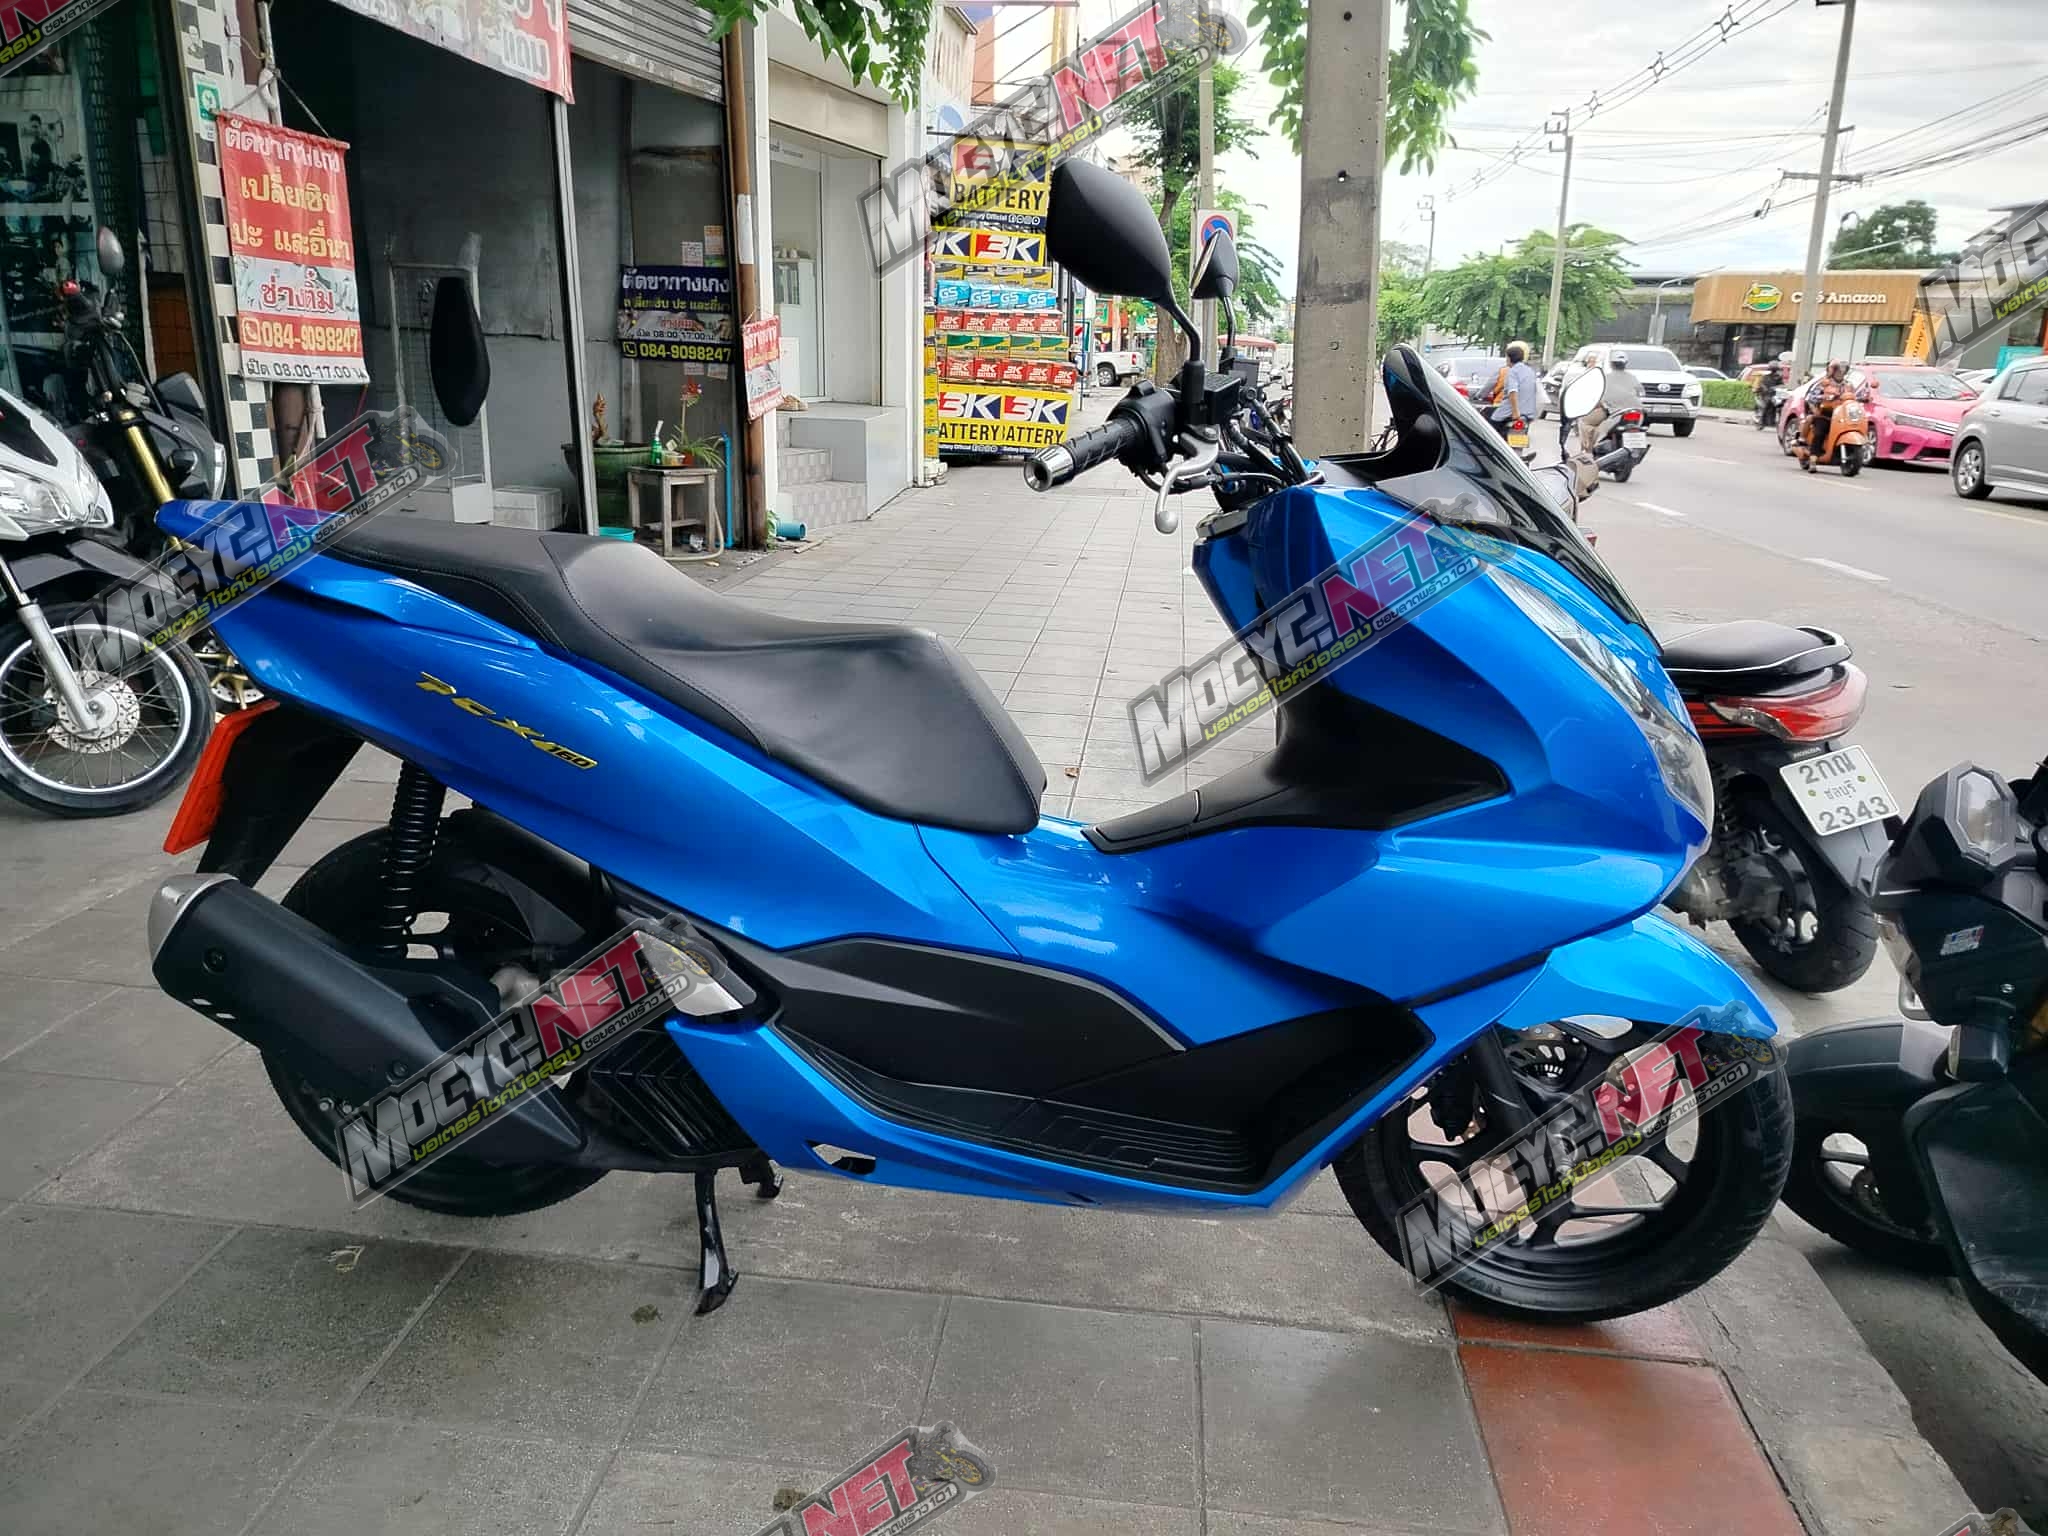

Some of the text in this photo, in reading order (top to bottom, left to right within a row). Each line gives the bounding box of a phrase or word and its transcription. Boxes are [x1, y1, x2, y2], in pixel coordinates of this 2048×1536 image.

[955, 183, 1044, 211] BATTERY
[232, 218, 263, 247] ปะ
[977, 232, 1039, 262] 3K
[622, 268, 730, 293] ตัดขากางเกง
[939, 287, 958, 299] GS
[971, 291, 991, 302] GS
[1000, 292, 1019, 303] GS
[1028, 293, 1047, 305] GS
[1791, 290, 1824, 303] Cé
[1826, 291, 1886, 303] Amazon
[261, 321, 358, 352] 084-9098247
[640, 343, 731, 361] 084-9098247
[940, 392, 1000, 419] 3K
[1005, 396, 1068, 424] 3K
[939, 422, 1001, 441] ATTERY
[1003, 426, 1064, 445] ATTERY
[1824, 780, 1857, 800] ชลบุรี
[1819, 796, 1890, 831] 2343
